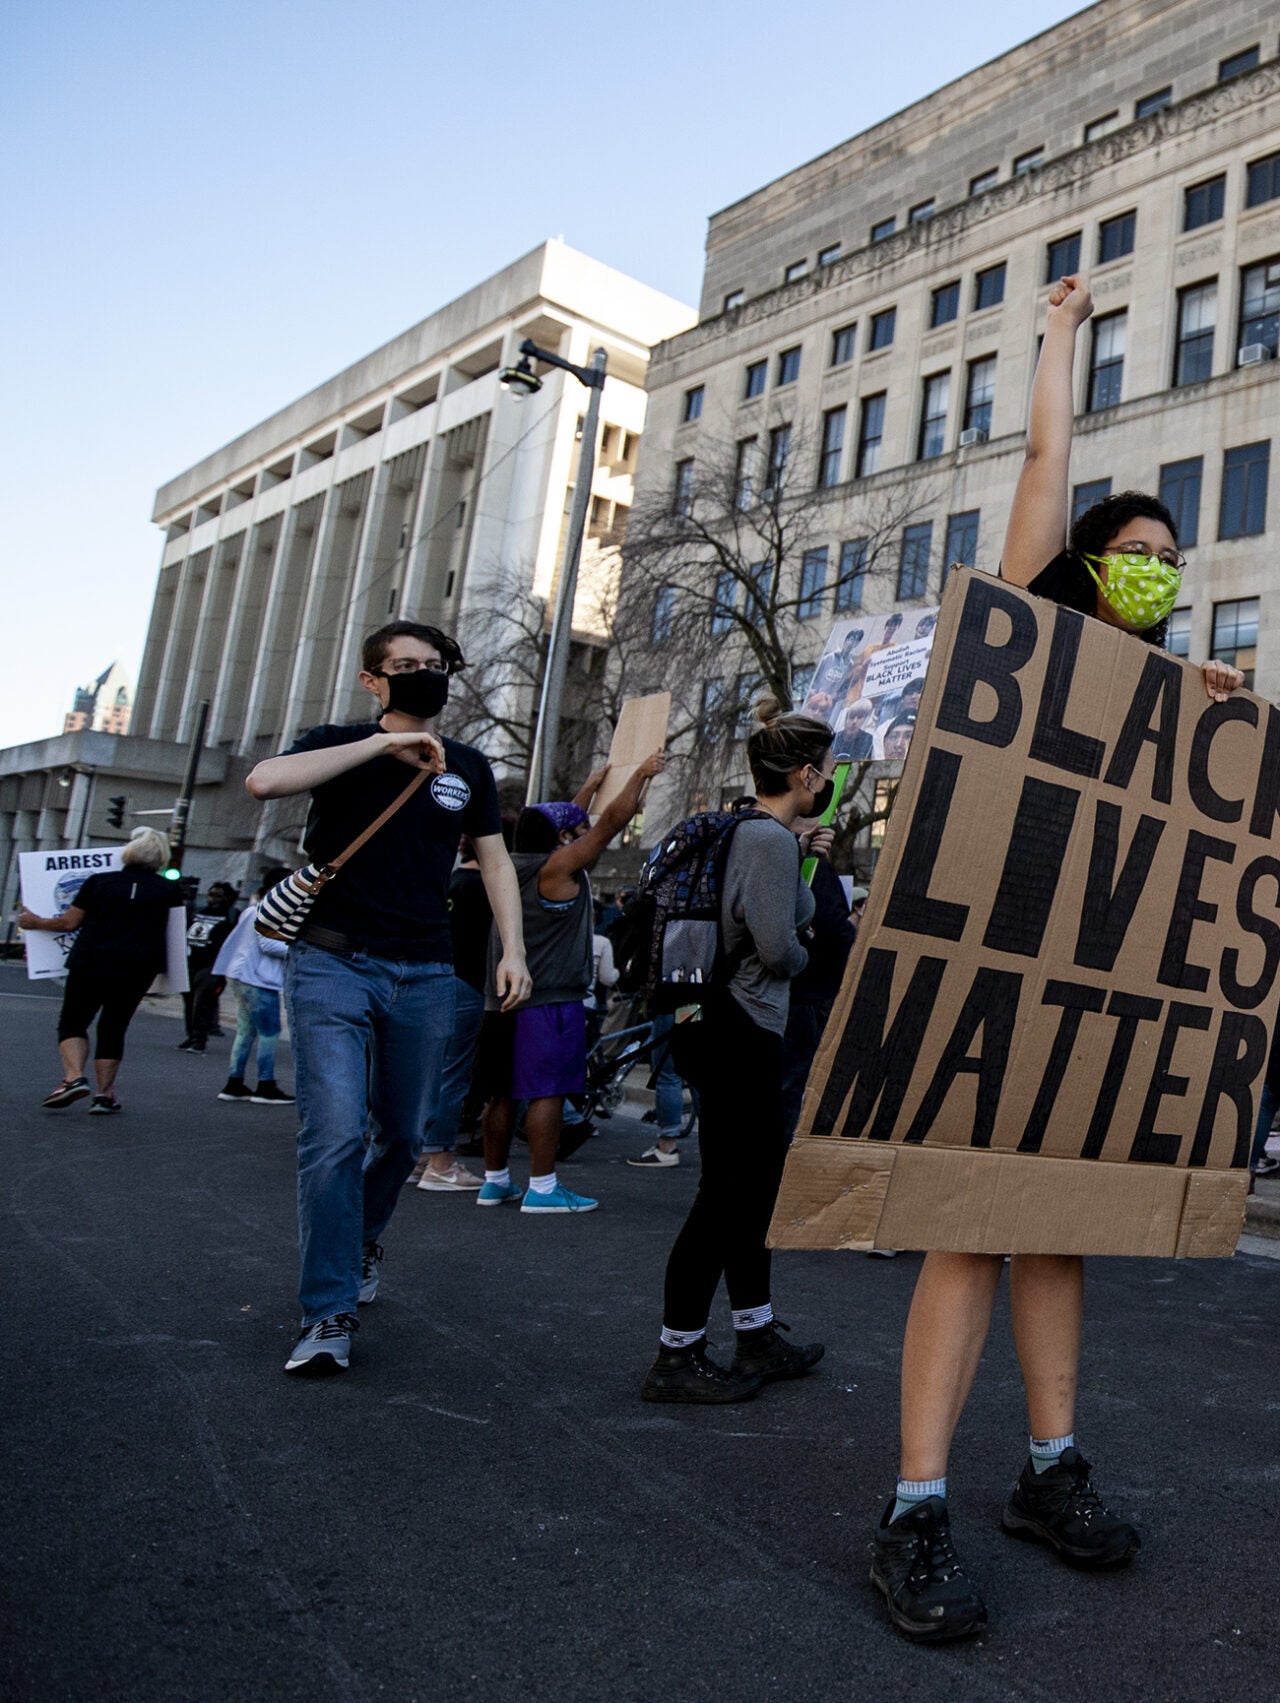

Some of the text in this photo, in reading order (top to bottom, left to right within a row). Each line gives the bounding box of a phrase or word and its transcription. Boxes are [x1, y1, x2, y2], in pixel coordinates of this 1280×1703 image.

[866, 660, 923, 684] BLACK LIVES
[878, 671, 913, 687] MATTER
[46, 853, 113, 871] ARREST
[810, 947, 1268, 1168] MATTER
